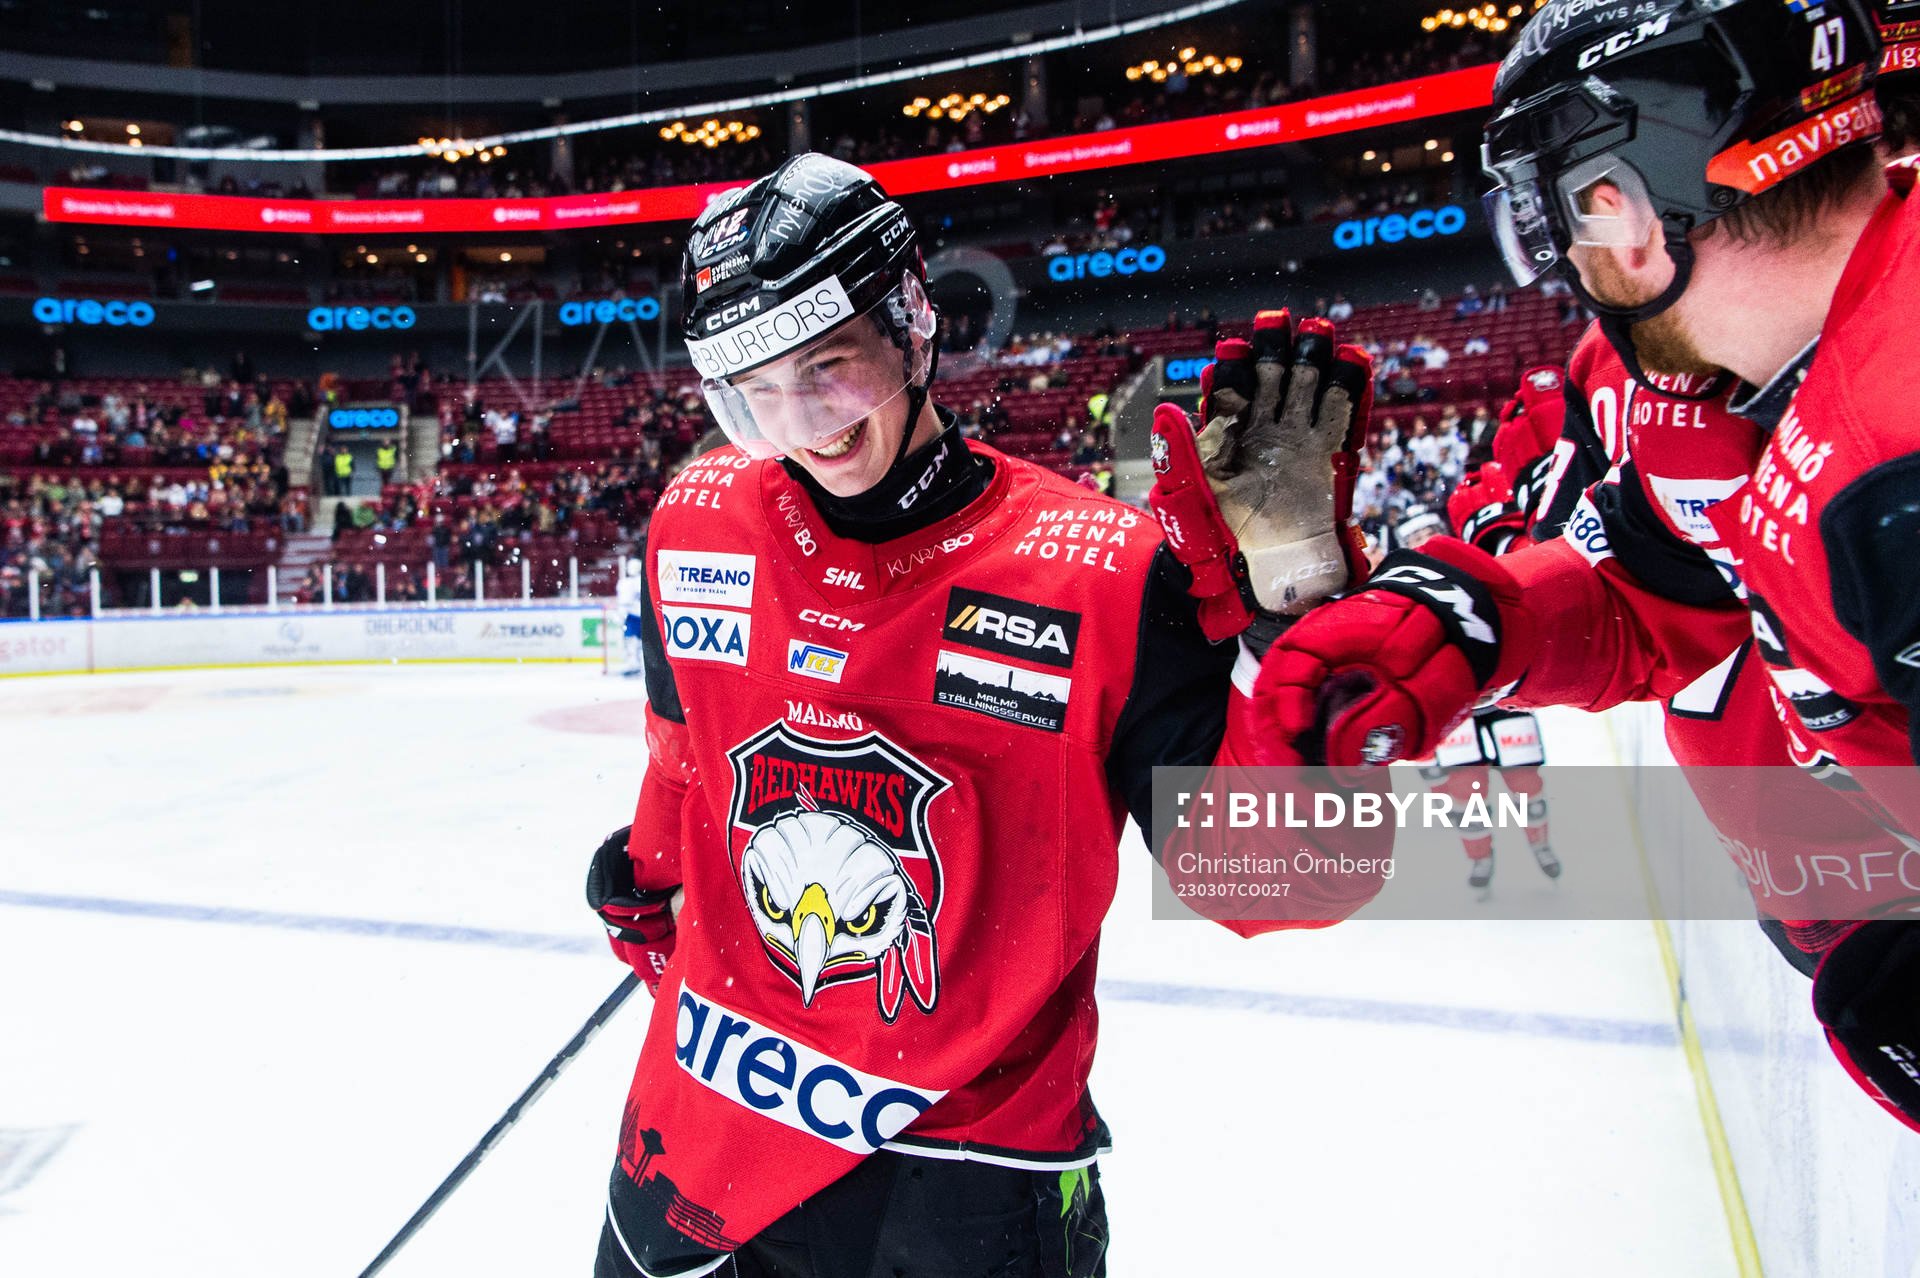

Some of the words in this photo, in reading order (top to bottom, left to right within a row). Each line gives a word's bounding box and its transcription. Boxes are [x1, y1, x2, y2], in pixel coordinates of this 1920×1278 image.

[1594, 7, 1629, 23] VVS
[1577, 13, 1672, 71] CCM
[1810, 16, 1846, 72] 47
[880, 216, 910, 247] CCM
[1332, 205, 1467, 250] areco
[711, 254, 751, 277] SVENSKA
[712, 270, 732, 285] SPEL
[1047, 244, 1166, 283] areco
[33, 297, 156, 326] areco
[307, 305, 417, 332] areco
[558, 297, 661, 328] areco
[705, 296, 761, 331] CCM
[699, 288, 841, 375] BJURFORS
[328, 408, 399, 430] areco
[897, 440, 950, 511] CCM
[656, 487, 721, 511] HOTEL
[1036, 507, 1140, 530] MALMÖ
[1740, 494, 1796, 566] OTEL
[1024, 523, 1127, 548] ARENA
[1013, 540, 1121, 573] HOTEL
[678, 566, 752, 587] TREANO
[822, 567, 866, 591] SHL
[798, 608, 866, 632] CCM
[1365, 565, 1498, 644] CM
[975, 607, 1071, 655] RSA
[0, 635, 67, 661] gator
[785, 699, 864, 732] MALMÖ
[938, 692, 1058, 727] STÄLLNINGSSERVICE
[976, 692, 1019, 709] MALMÖ
[747, 753, 907, 839] REDHAWKS
[676, 991, 934, 1149] areco
